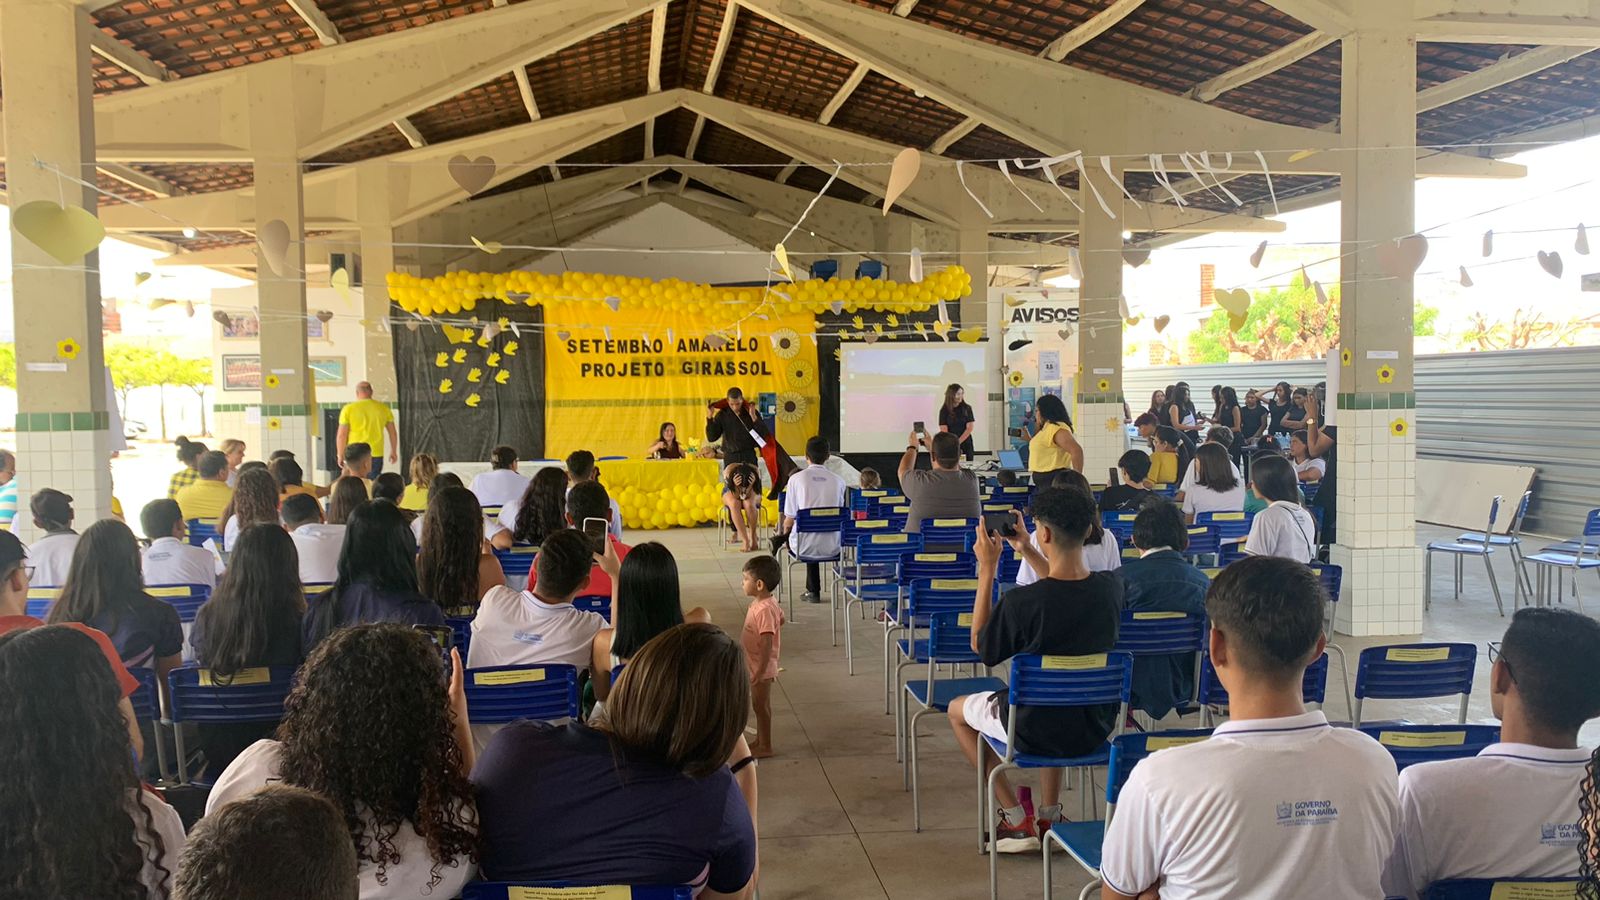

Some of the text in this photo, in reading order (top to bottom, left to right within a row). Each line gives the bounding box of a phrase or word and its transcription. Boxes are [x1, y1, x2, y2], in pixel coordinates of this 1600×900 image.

[1011, 307, 1079, 323] AVISOS
[567, 338, 663, 354] SETEMBRO
[581, 361, 772, 377] PROJETO GIRASSOL
[1295, 800, 1331, 809] GOVERNO
